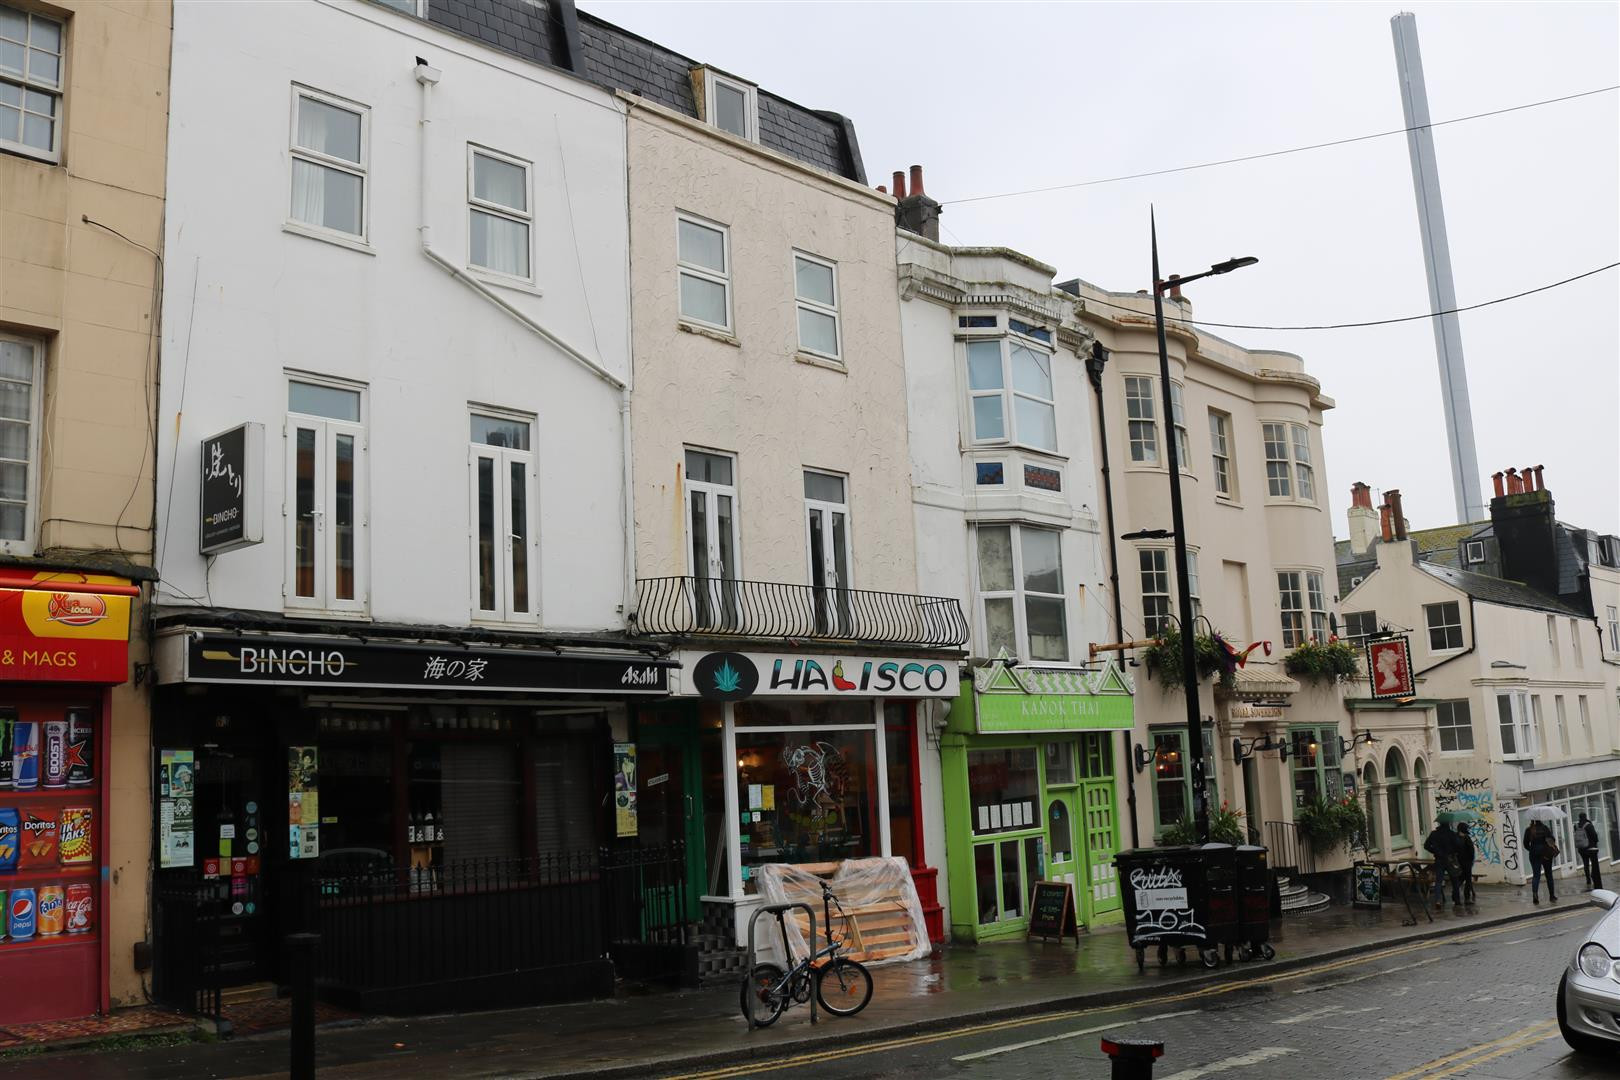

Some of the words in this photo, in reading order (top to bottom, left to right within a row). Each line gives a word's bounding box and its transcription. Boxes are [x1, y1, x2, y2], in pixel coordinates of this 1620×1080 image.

[71, 606, 92, 615] LOCAL
[2, 649, 15, 666] &
[23, 650, 77, 667] MAGS
[240, 648, 344, 676] BINCHO
[424, 656, 488, 682] 海の家
[621, 666, 658, 685] Asahi
[1021, 702, 1066, 716] KANOK
[1072, 701, 1100, 716] THAI
[50, 739, 60, 774] BOOST
[24, 821, 56, 831] Doritos
[13, 921, 32, 929] pepsi
